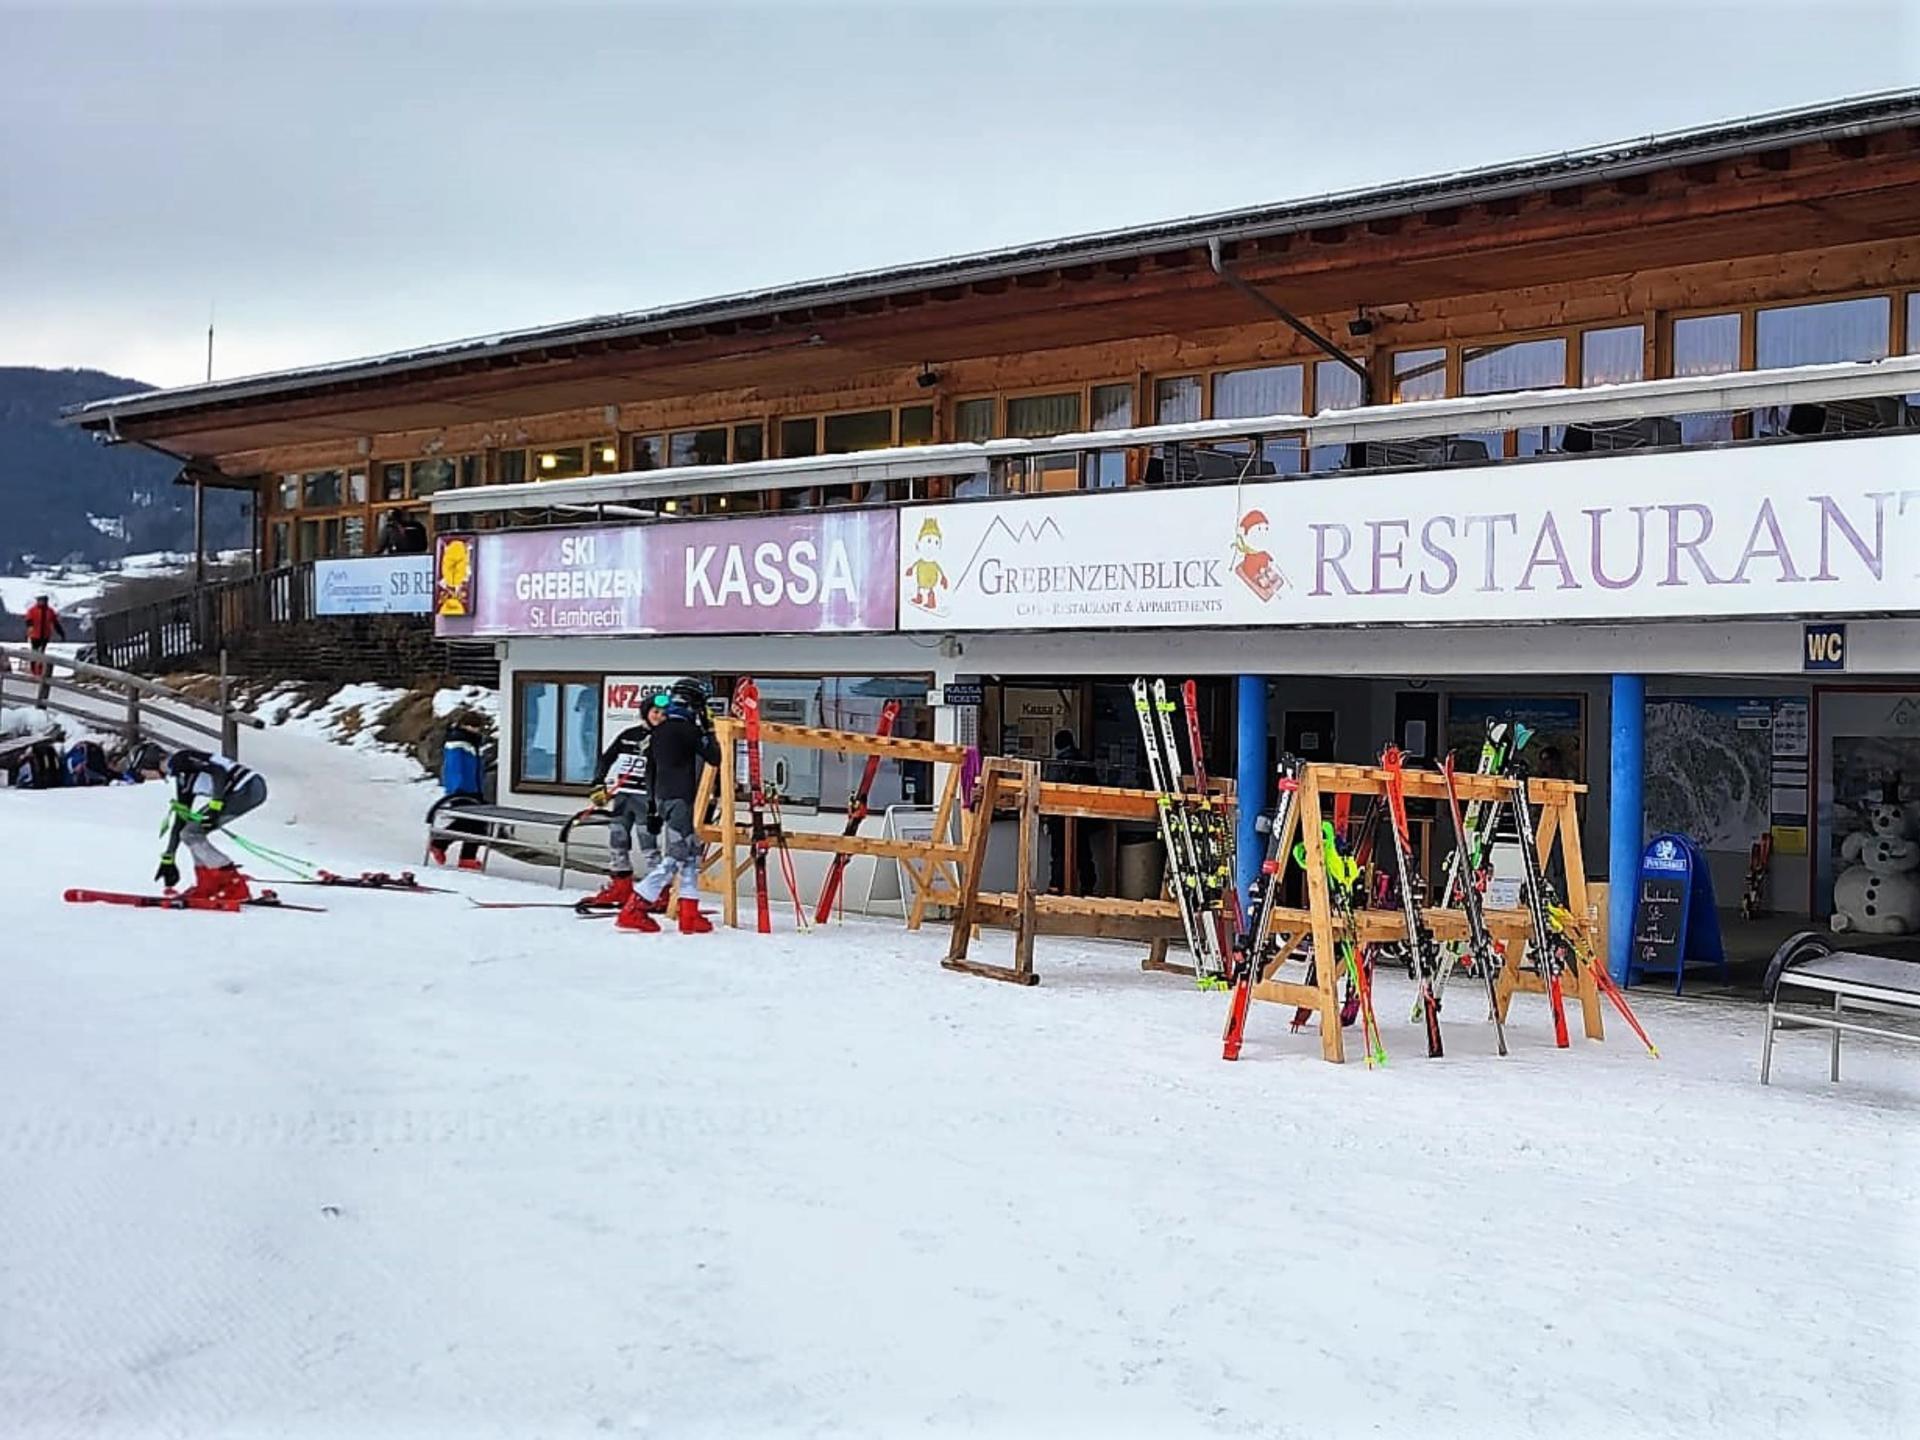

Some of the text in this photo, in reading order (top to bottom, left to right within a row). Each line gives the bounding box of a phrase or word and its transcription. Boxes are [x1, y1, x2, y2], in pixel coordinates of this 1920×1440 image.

[561, 536, 596, 566] SKI
[390, 572, 410, 596] SB
[515, 569, 643, 601] GREBENZEN
[684, 539, 858, 609] KASSA
[978, 557, 1223, 596] GREBENZENBLICK
[551, 604, 627, 627] Lambrecht
[1053, 601, 1121, 615] RSTAURANT
[1807, 632, 1843, 662] WC
[607, 684, 643, 709] KFZ
[945, 685, 982, 694] KASSA
[947, 695, 982, 703] TICKETS
